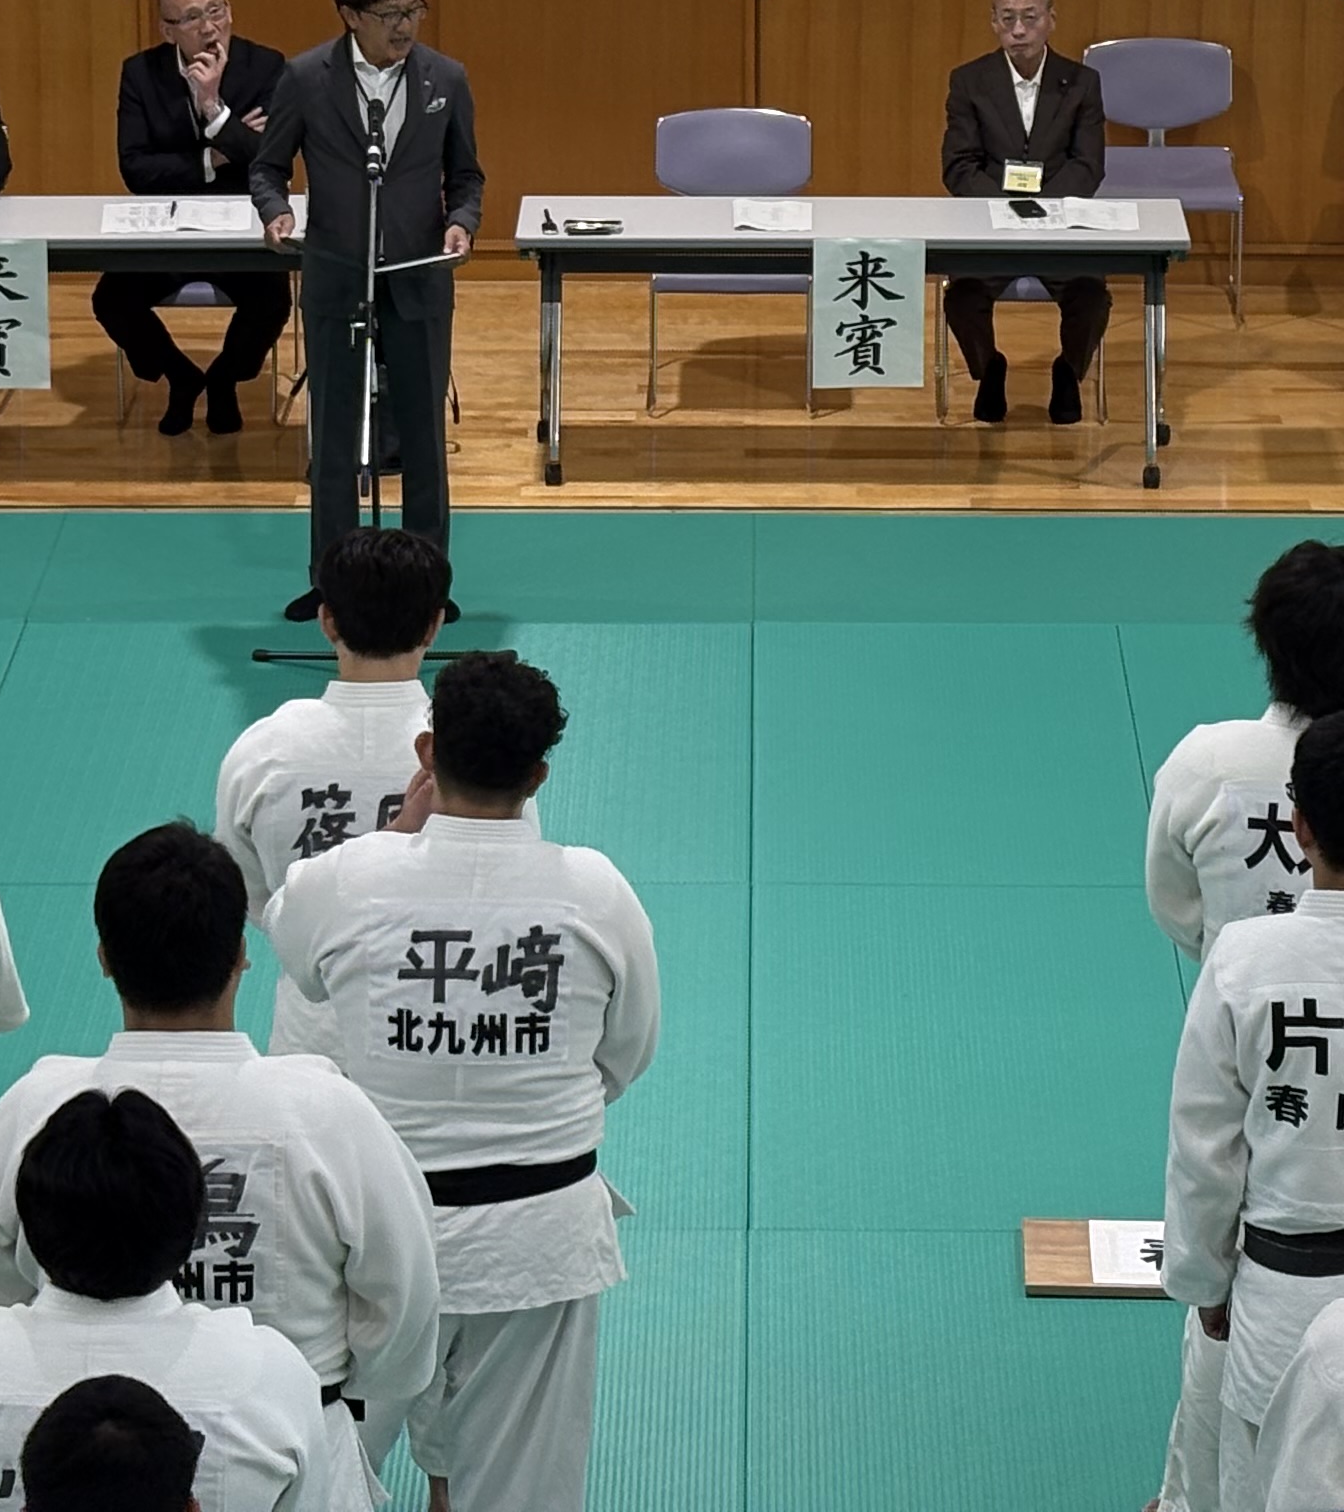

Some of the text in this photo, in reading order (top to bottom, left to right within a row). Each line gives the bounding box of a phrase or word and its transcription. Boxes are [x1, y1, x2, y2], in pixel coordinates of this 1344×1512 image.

[833, 250, 905, 376] 来賓
[387, 1008, 552, 1057] 北九州市
